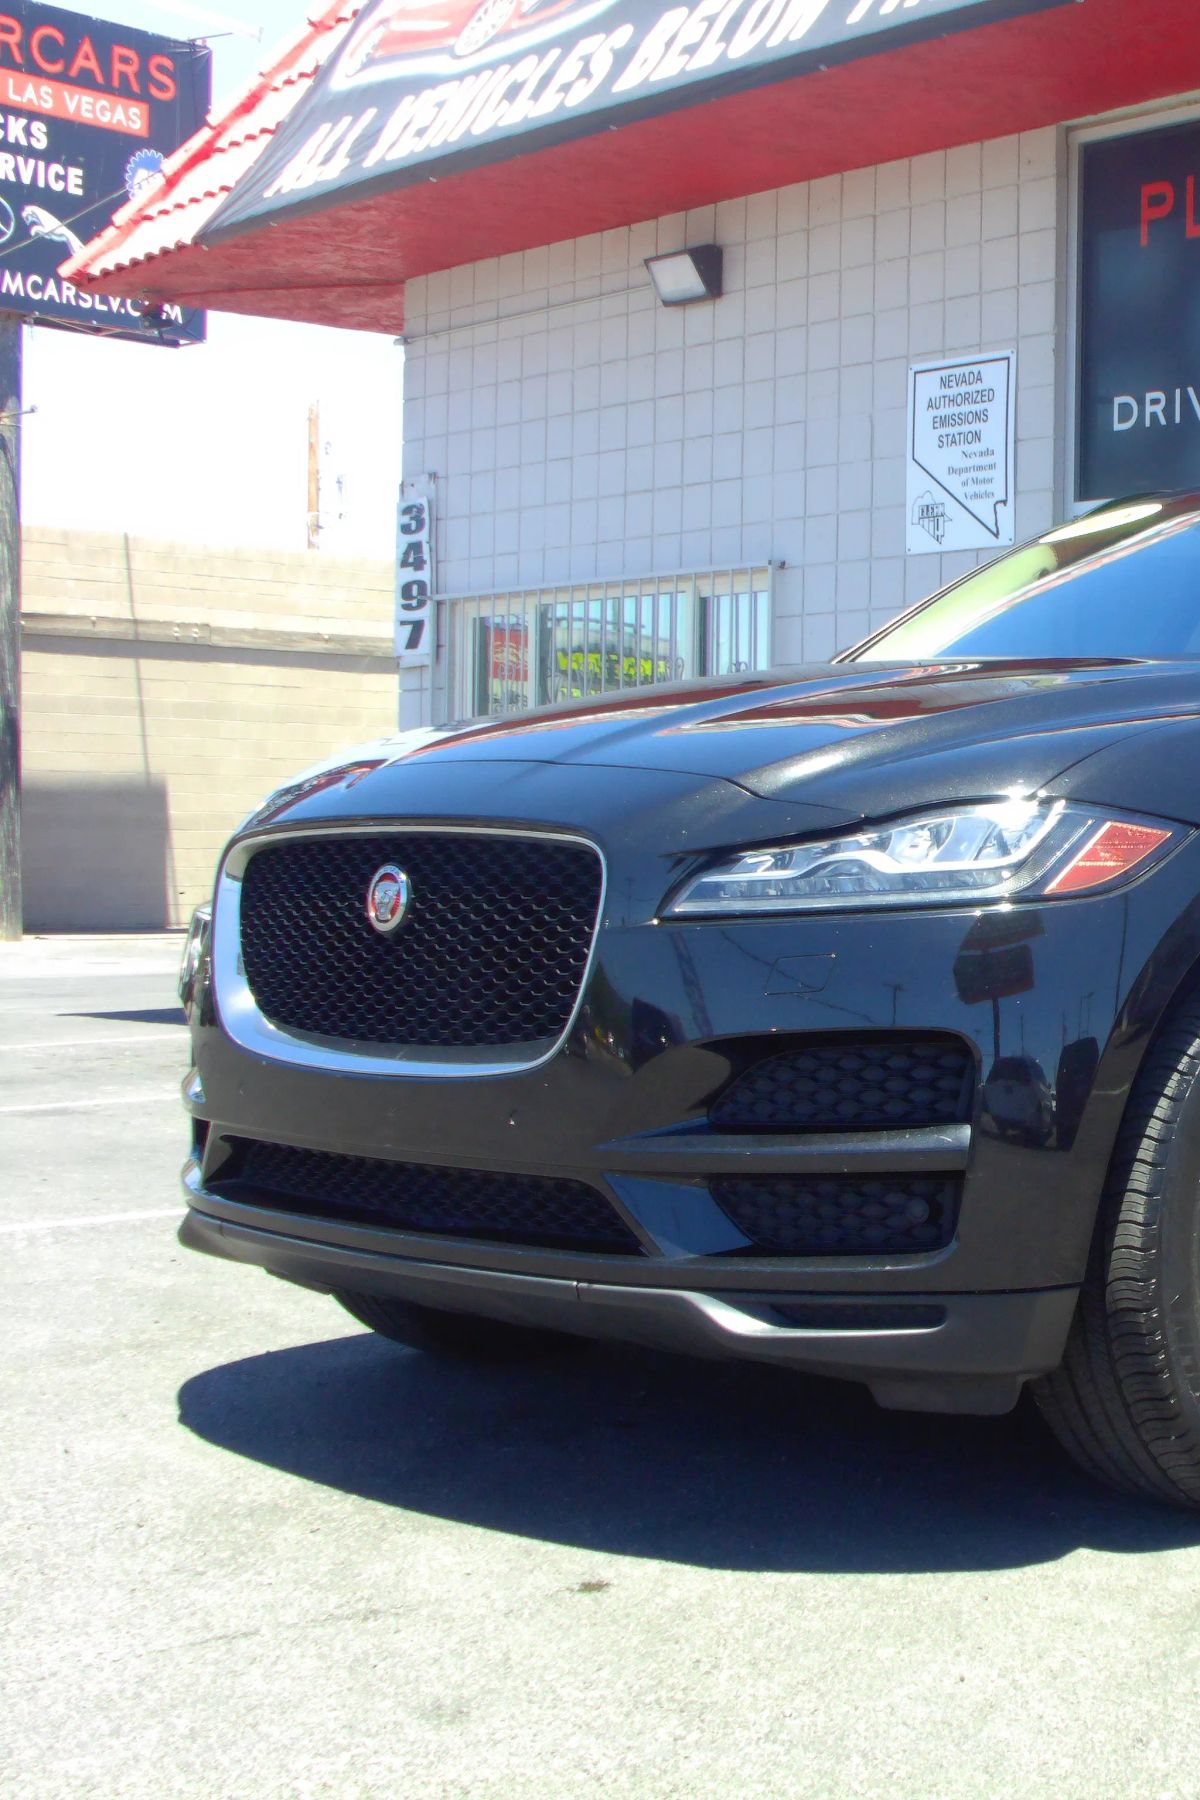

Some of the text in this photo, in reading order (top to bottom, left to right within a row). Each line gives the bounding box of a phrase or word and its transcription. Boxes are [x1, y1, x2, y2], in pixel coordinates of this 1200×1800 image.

[8, 78, 141, 130] LAS VEGAS
[263, 107, 378, 198] ALL
[362, 24, 634, 168] VEHICLES
[0, 112, 48, 150] KS
[939, 370, 983, 390] NEVADA
[926, 388, 995, 412] AUTHORIZED
[932, 408, 989, 430] EMISSIONS
[937, 430, 982, 449] STATION
[961, 448, 995, 459] Nevada
[947, 462, 996, 477] Department
[964, 490, 995, 500] Vehicles
